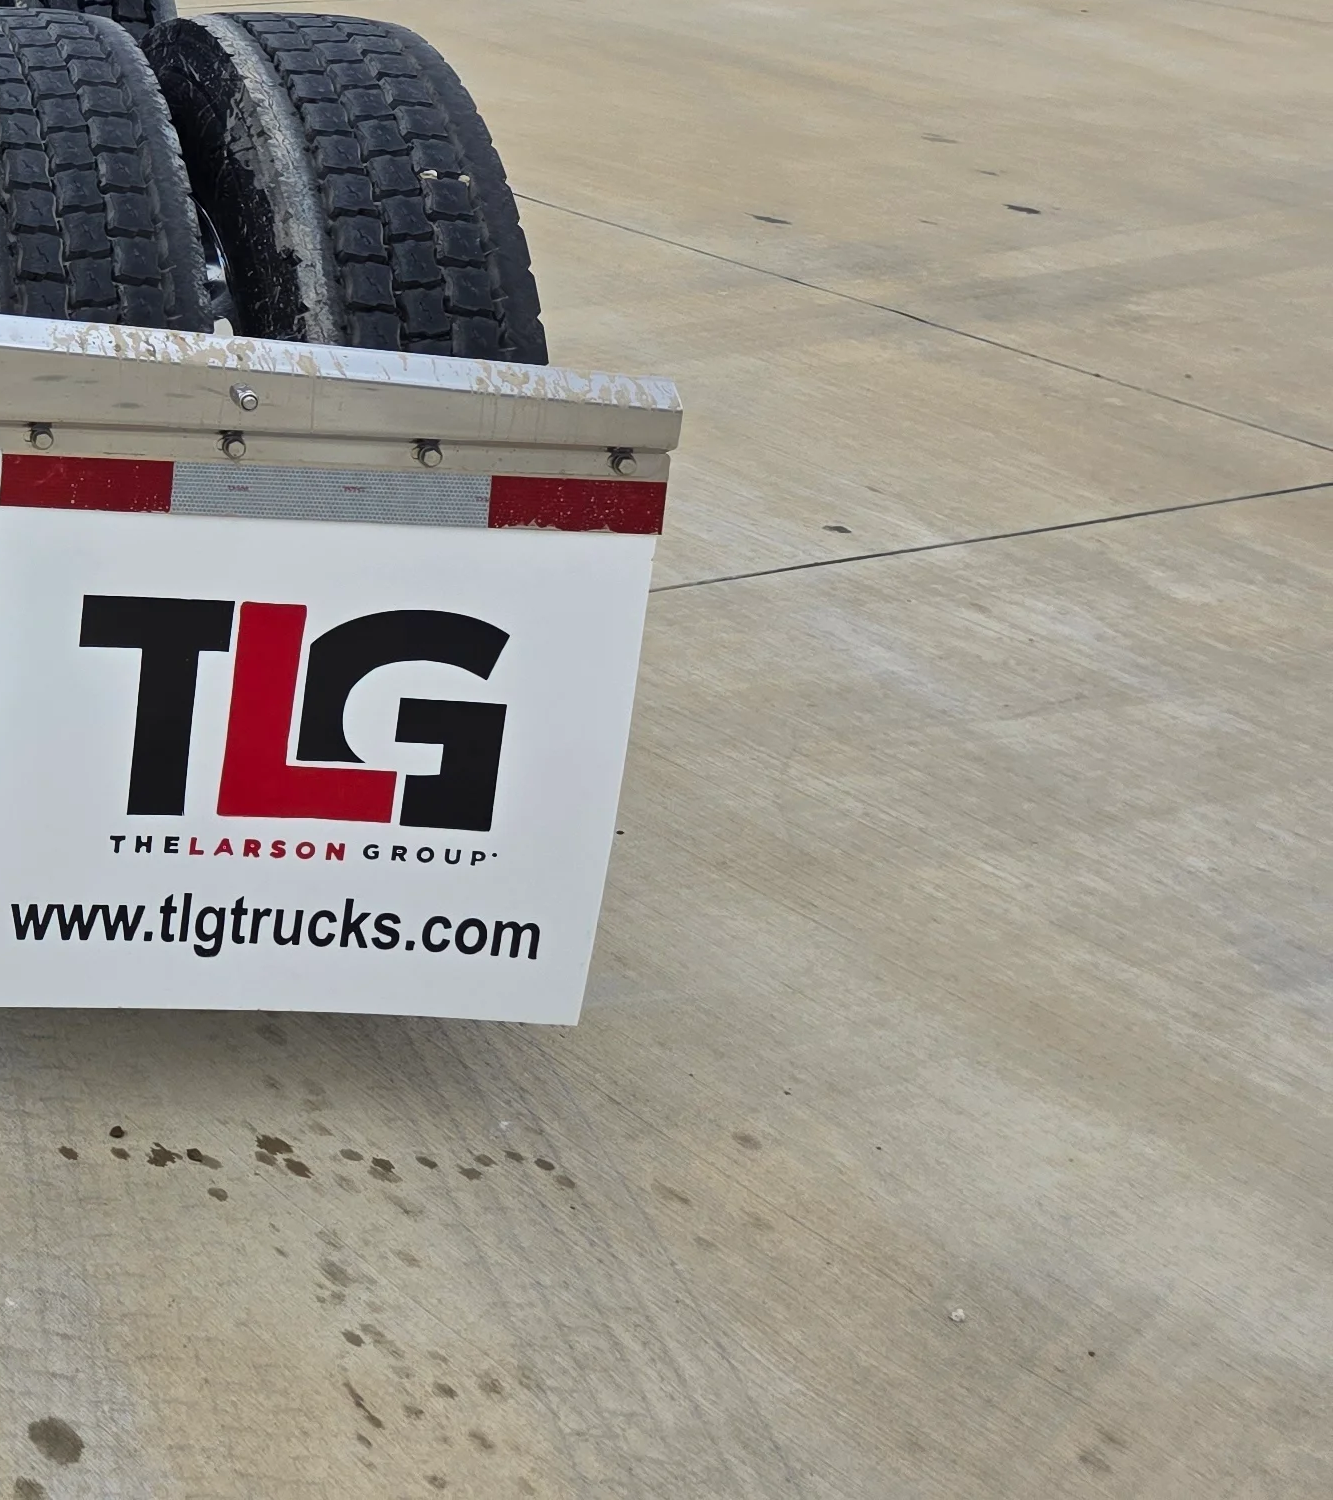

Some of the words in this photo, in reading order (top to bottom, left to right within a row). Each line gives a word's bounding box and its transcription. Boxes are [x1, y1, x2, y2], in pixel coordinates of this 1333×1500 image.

[78, 594, 510, 833] TLG
[362, 843, 488, 868] GROUP
[9, 892, 541, 960] www.tlgtrucks.com
